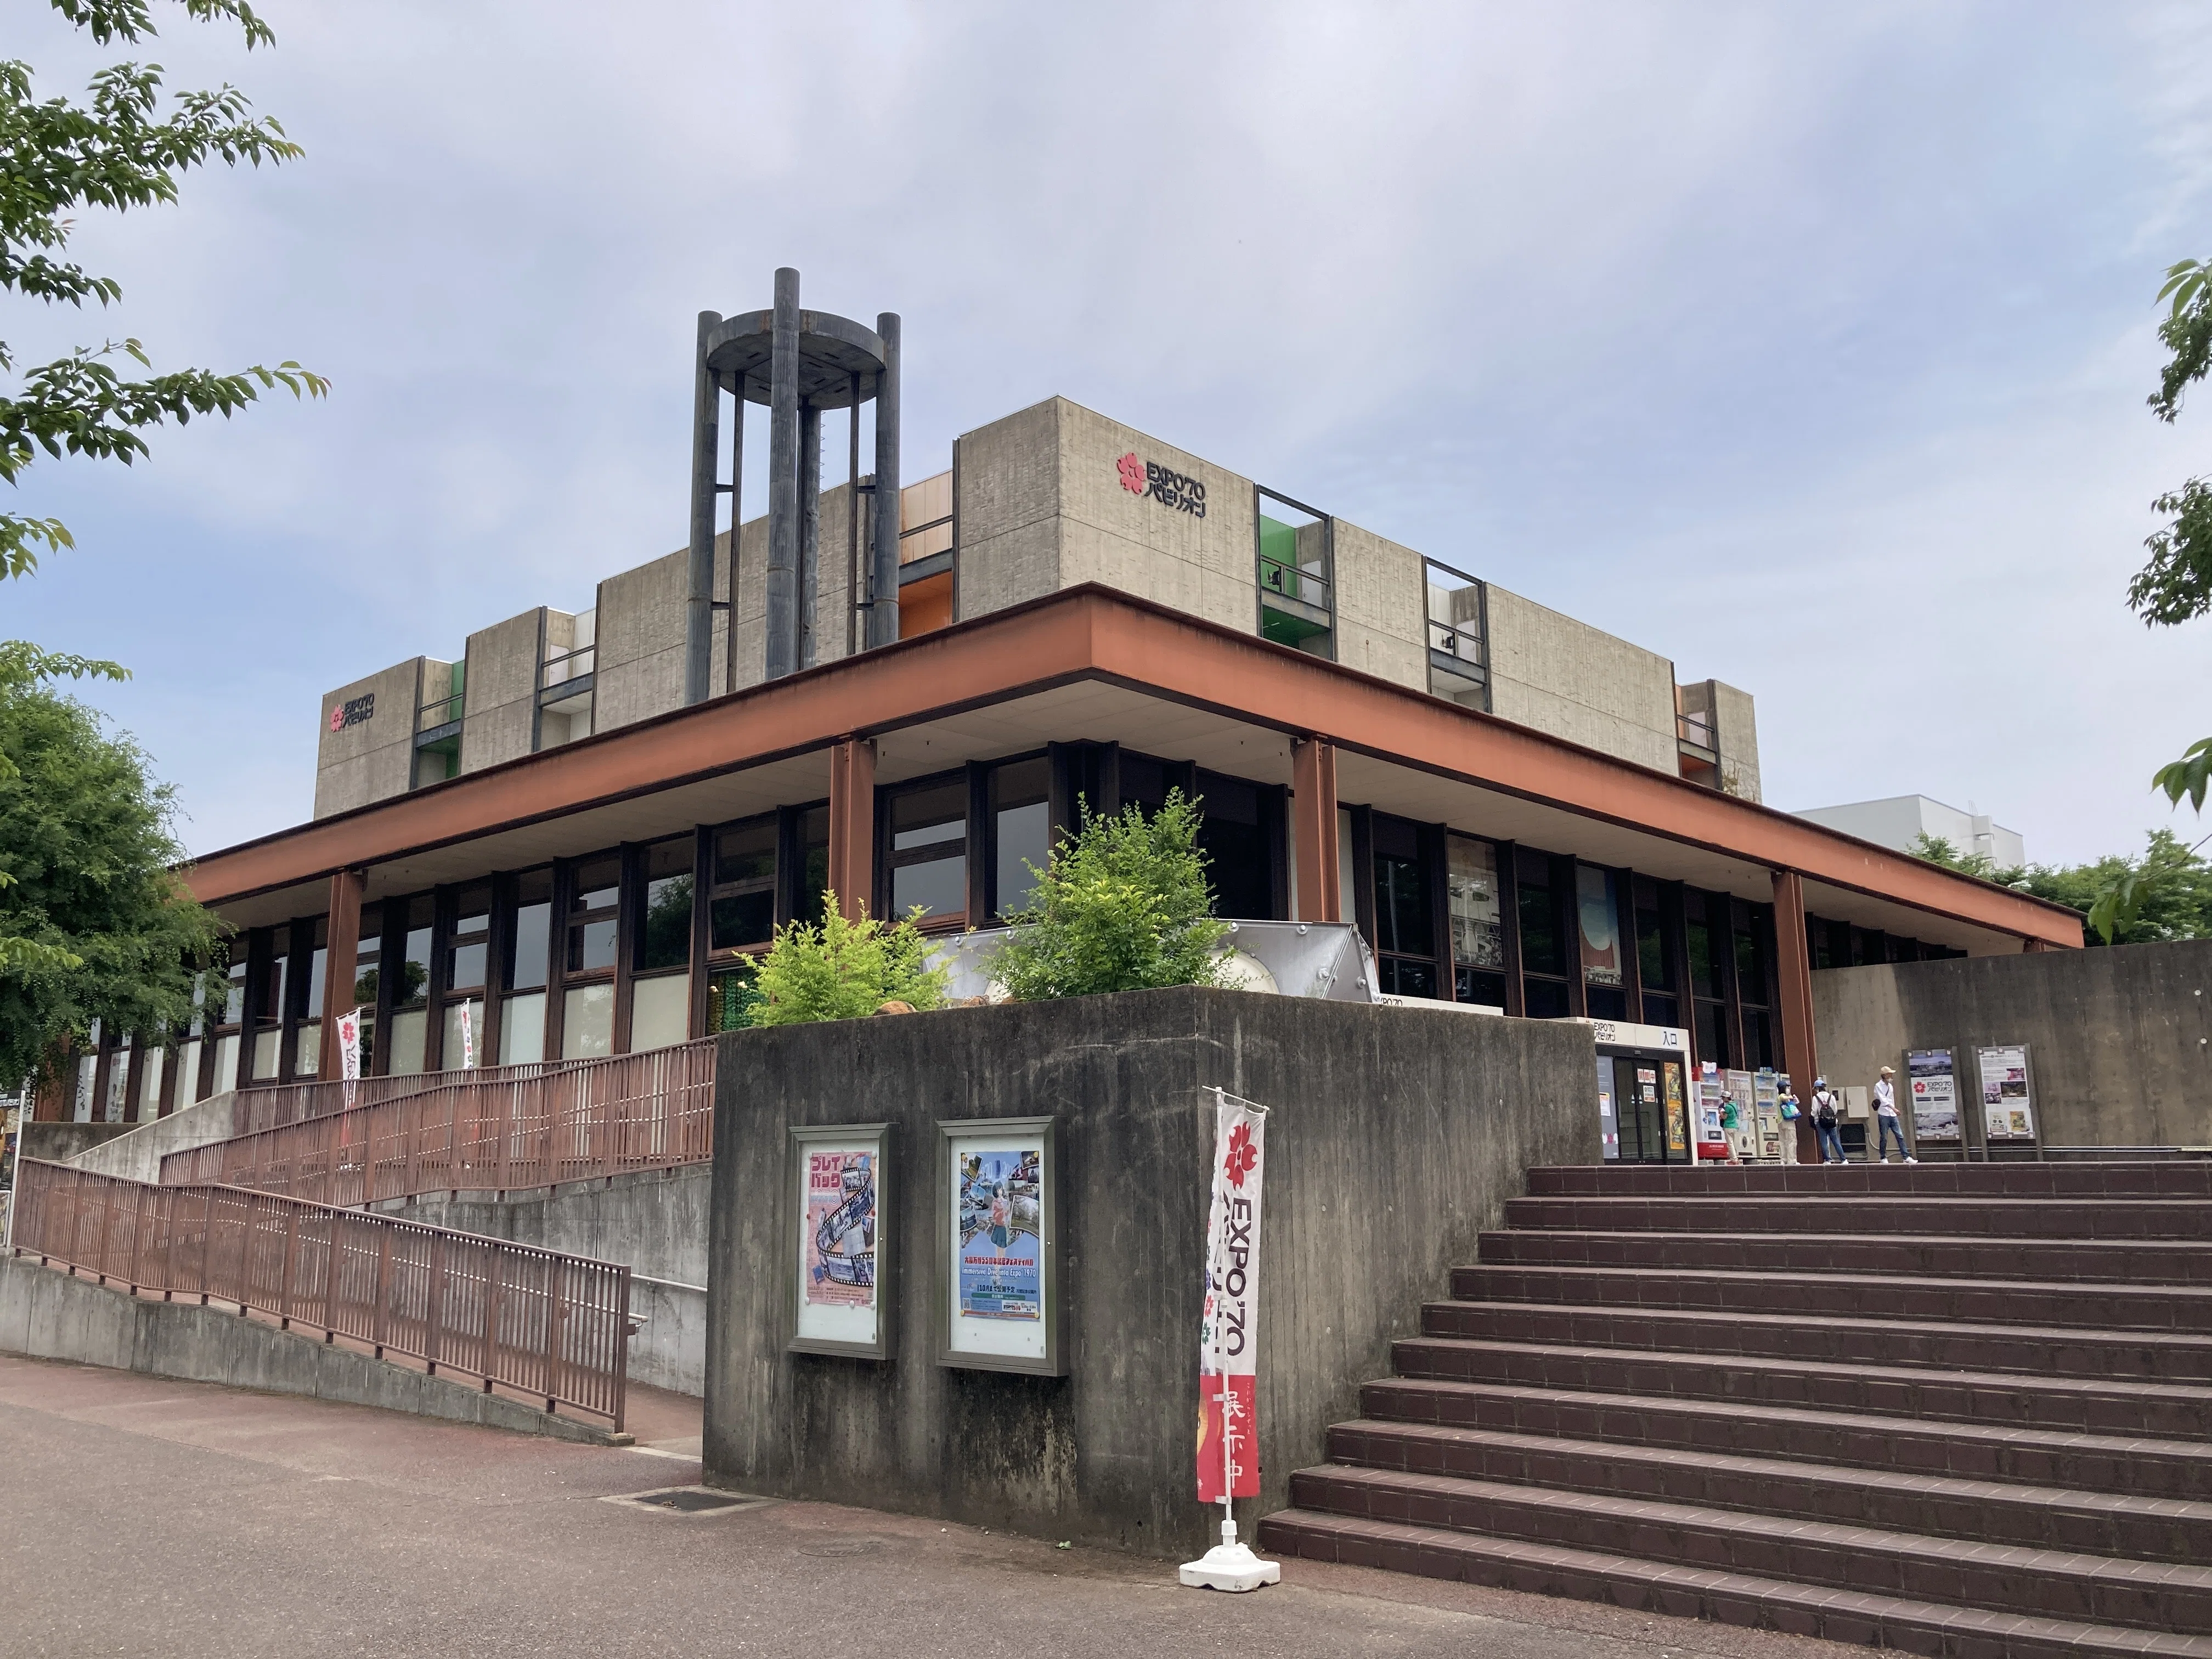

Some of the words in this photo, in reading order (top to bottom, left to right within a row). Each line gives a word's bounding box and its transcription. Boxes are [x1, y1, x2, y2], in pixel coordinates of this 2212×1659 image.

[1144, 482, 1206, 518] パビリオン
[1594, 1031, 1616, 1042] パビリオン
[1663, 1031, 1677, 1046] 入口
[962, 1266, 986, 1276] Immersive
[988, 1267, 998, 1276] Dive
[999, 1268, 1009, 1277] into
